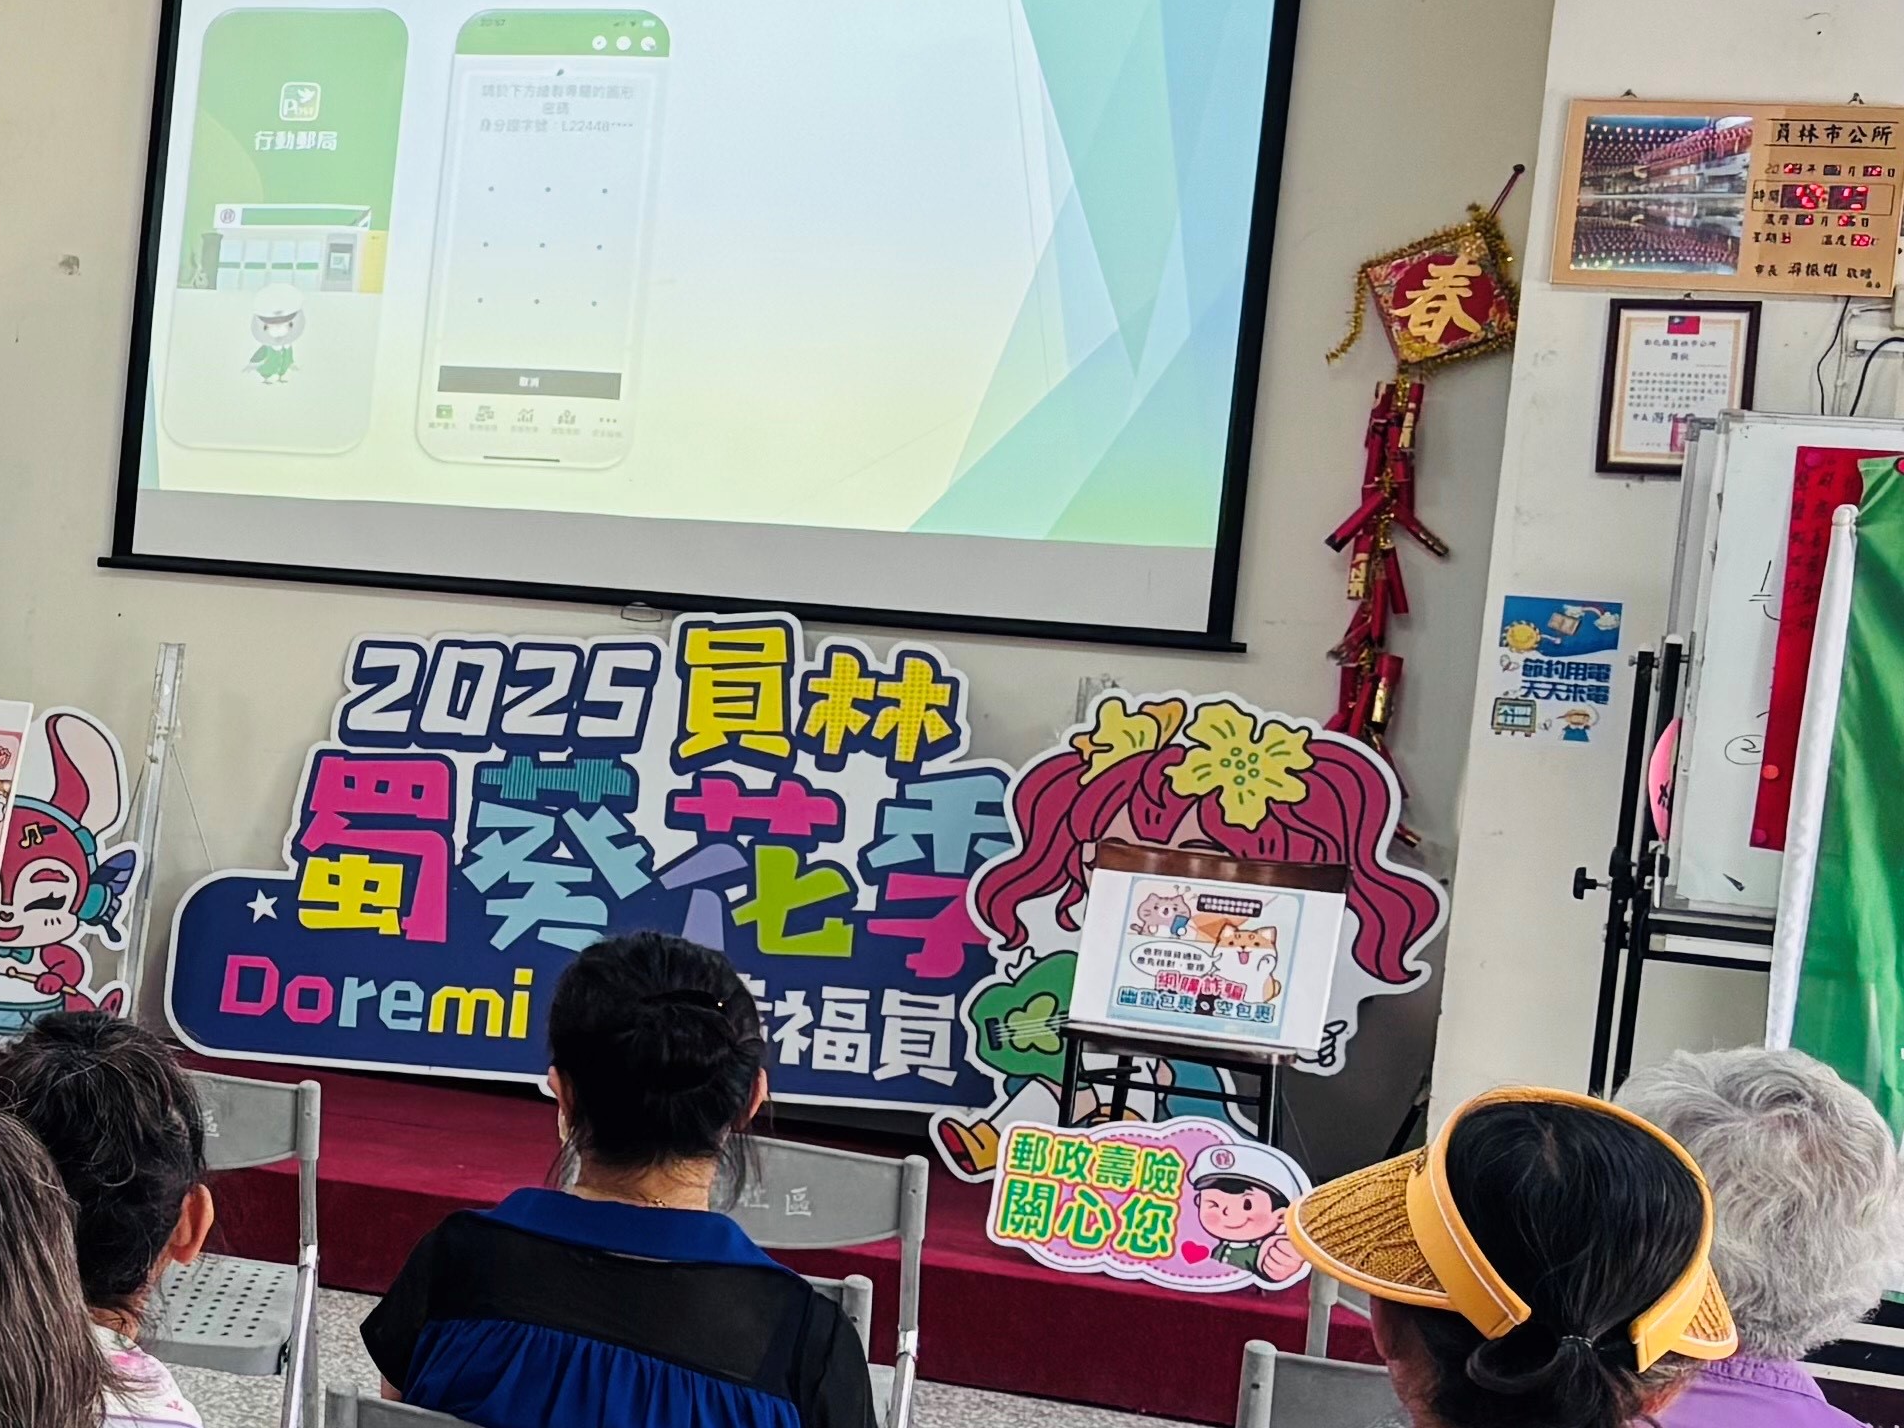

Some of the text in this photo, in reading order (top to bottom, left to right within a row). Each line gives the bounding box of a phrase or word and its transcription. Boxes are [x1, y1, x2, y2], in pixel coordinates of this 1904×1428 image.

[254, 130, 338, 152] 行動郵局
[1774, 123, 1894, 147] 員林市公所
[1392, 258, 1485, 343] 春
[342, 622, 962, 764] 2025 員林
[297, 754, 1016, 980] 蜀葵花季
[219, 954, 958, 1087] Doremi 福員
[1158, 971, 1246, 1000] 網購詐騙
[1011, 1131, 1182, 1196] 郵政壽險
[1000, 1179, 1174, 1255] 關心您
